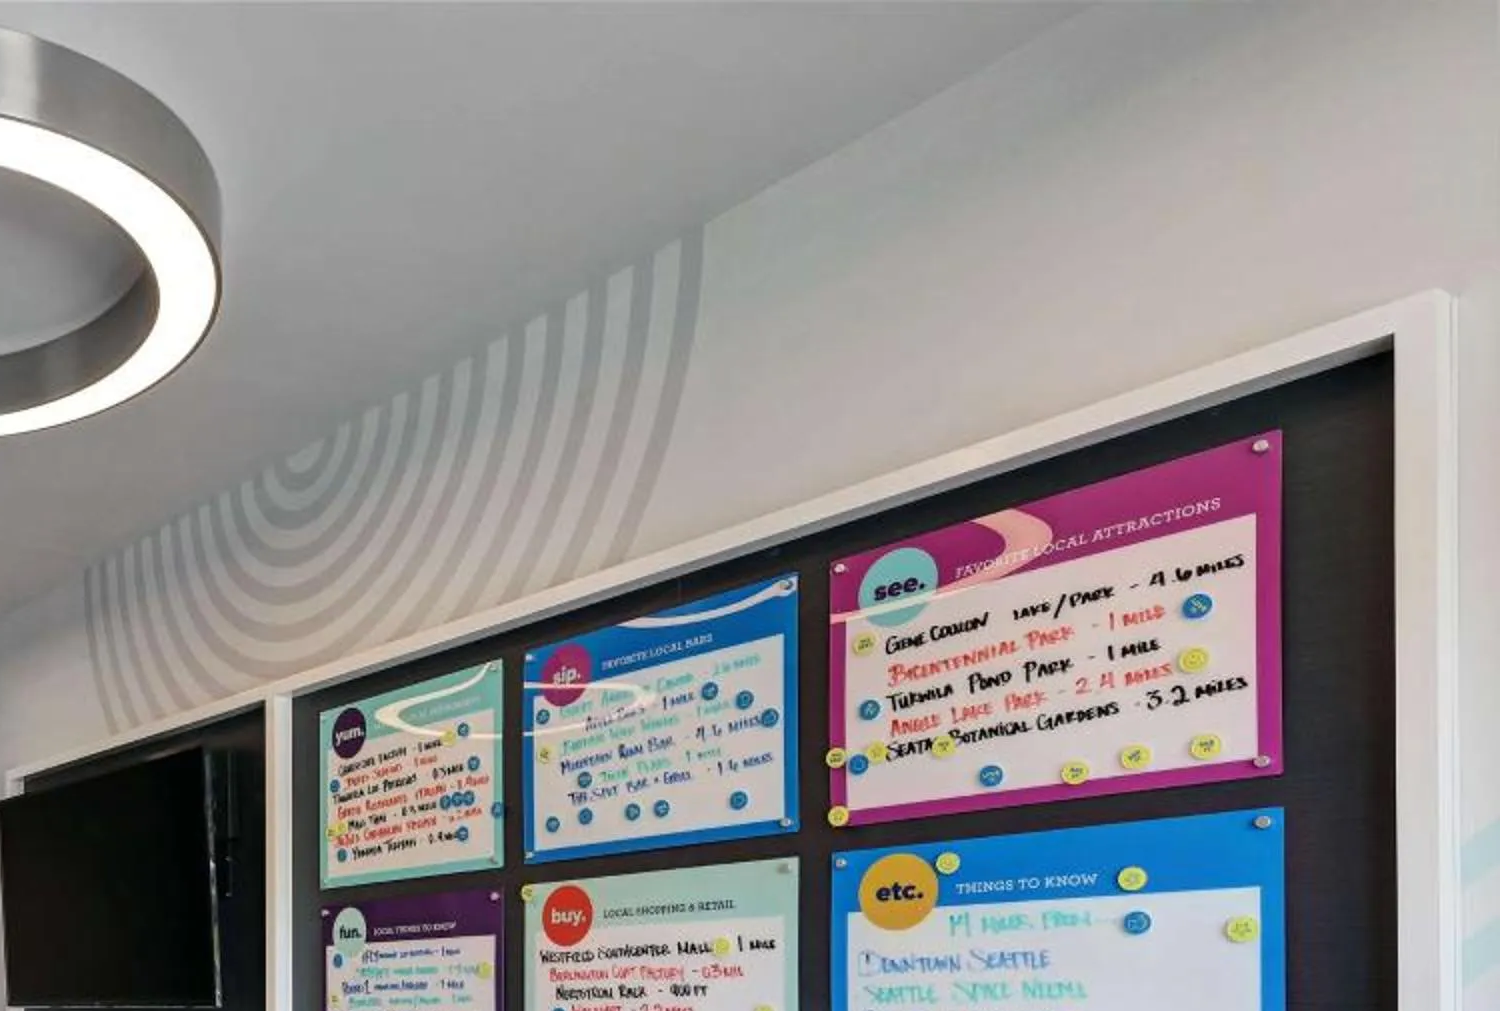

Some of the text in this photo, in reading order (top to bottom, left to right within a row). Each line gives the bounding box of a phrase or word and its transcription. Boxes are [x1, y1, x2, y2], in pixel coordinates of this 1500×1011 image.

[955, 497, 1222, 579] FAVORITE LOCAL ATTRACTIONS
[1196, 553, 1245, 577] MILES
[874, 577, 925, 602] see.
[1024, 624, 1075, 649] PARK
[553, 666, 581, 688] sip.
[886, 684, 953, 711] TUKWILA
[968, 671, 1012, 694] POND
[1023, 658, 1074, 682] PARK
[1121, 638, 1161, 658] MILE
[1036, 702, 1120, 731] GARDENS
[1195, 676, 1249, 699] MILES
[875, 881, 924, 902] etc.
[955, 872, 1099, 895] THINGS TO KNOW
[551, 907, 586, 927] buy.
[604, 907, 634, 919] LOCAL
[340, 924, 362, 939] fun.
